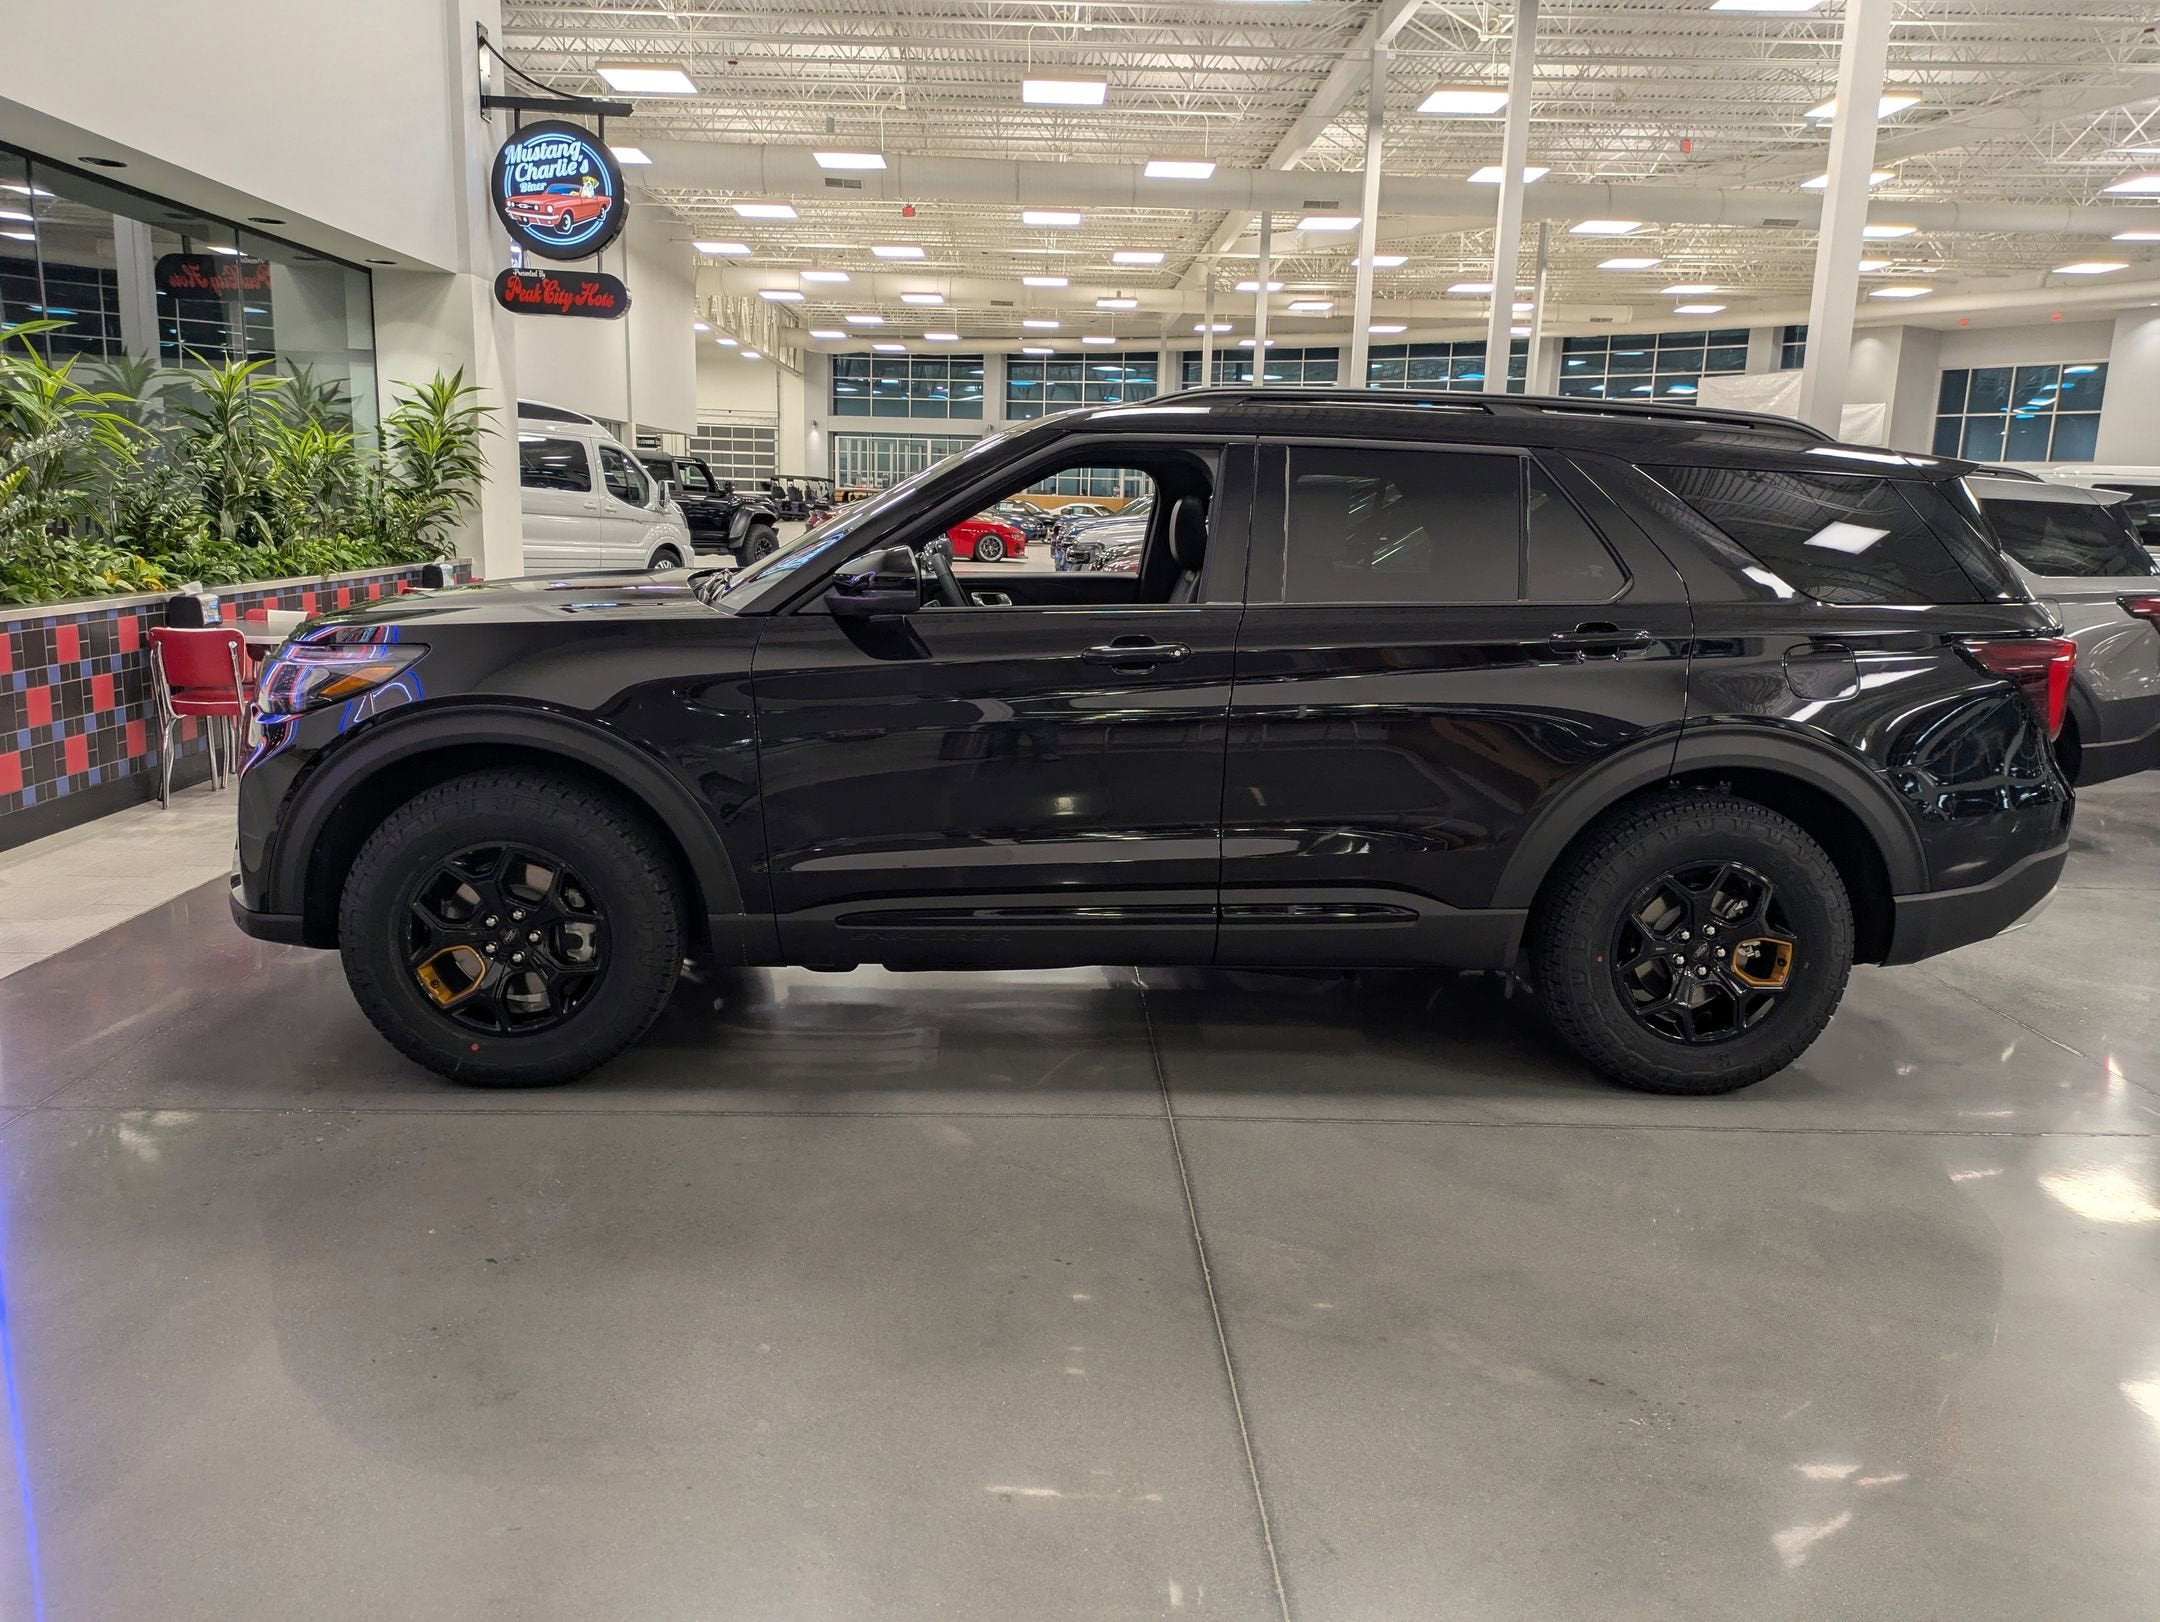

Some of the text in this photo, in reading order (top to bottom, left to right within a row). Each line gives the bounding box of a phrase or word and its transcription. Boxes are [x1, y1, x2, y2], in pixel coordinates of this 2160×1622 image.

[504, 141, 581, 164] Mustang
[514, 154, 589, 181] Charlie's
[505, 277, 614, 312] Peak City Hots
